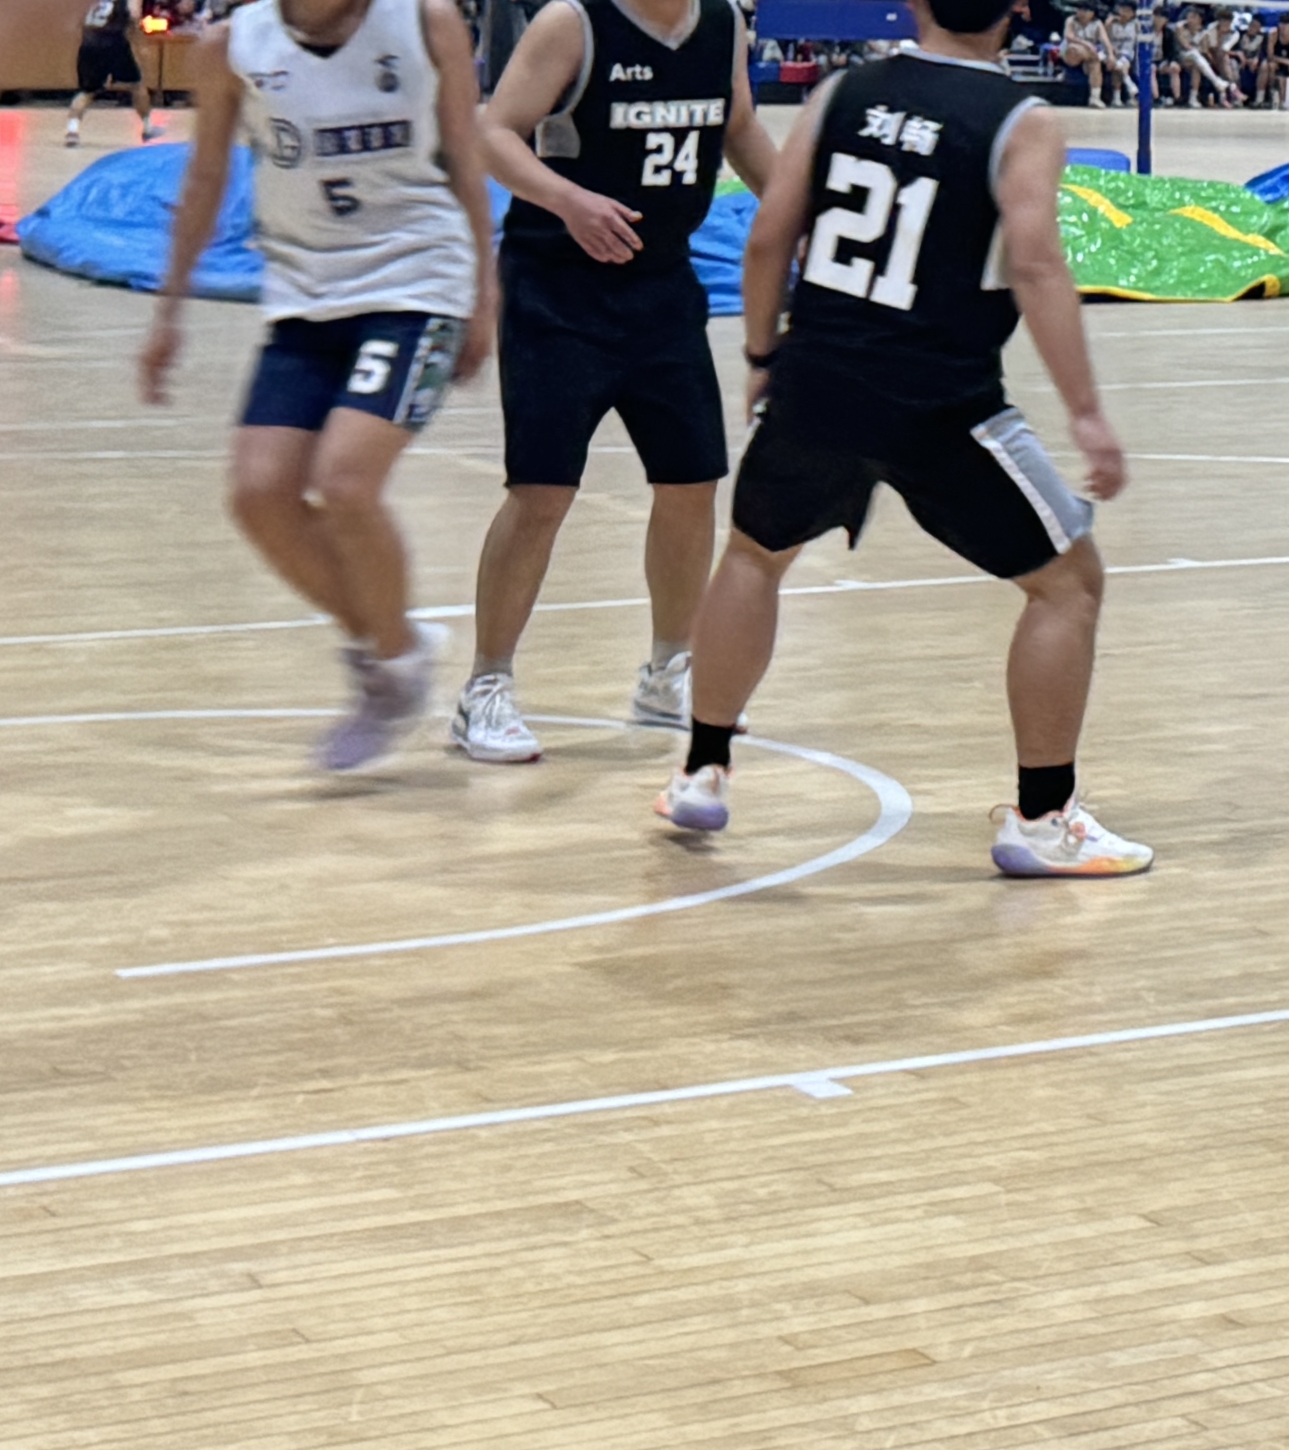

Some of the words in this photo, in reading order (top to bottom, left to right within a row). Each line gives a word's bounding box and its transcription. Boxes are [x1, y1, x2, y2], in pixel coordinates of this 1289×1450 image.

[609, 63, 653, 82] Arts
[610, 98, 725, 129] IGNITE
[641, 130, 700, 186] 24
[320, 178, 360, 217] 5
[803, 152, 940, 311] 21
[346, 339, 400, 394] 5
